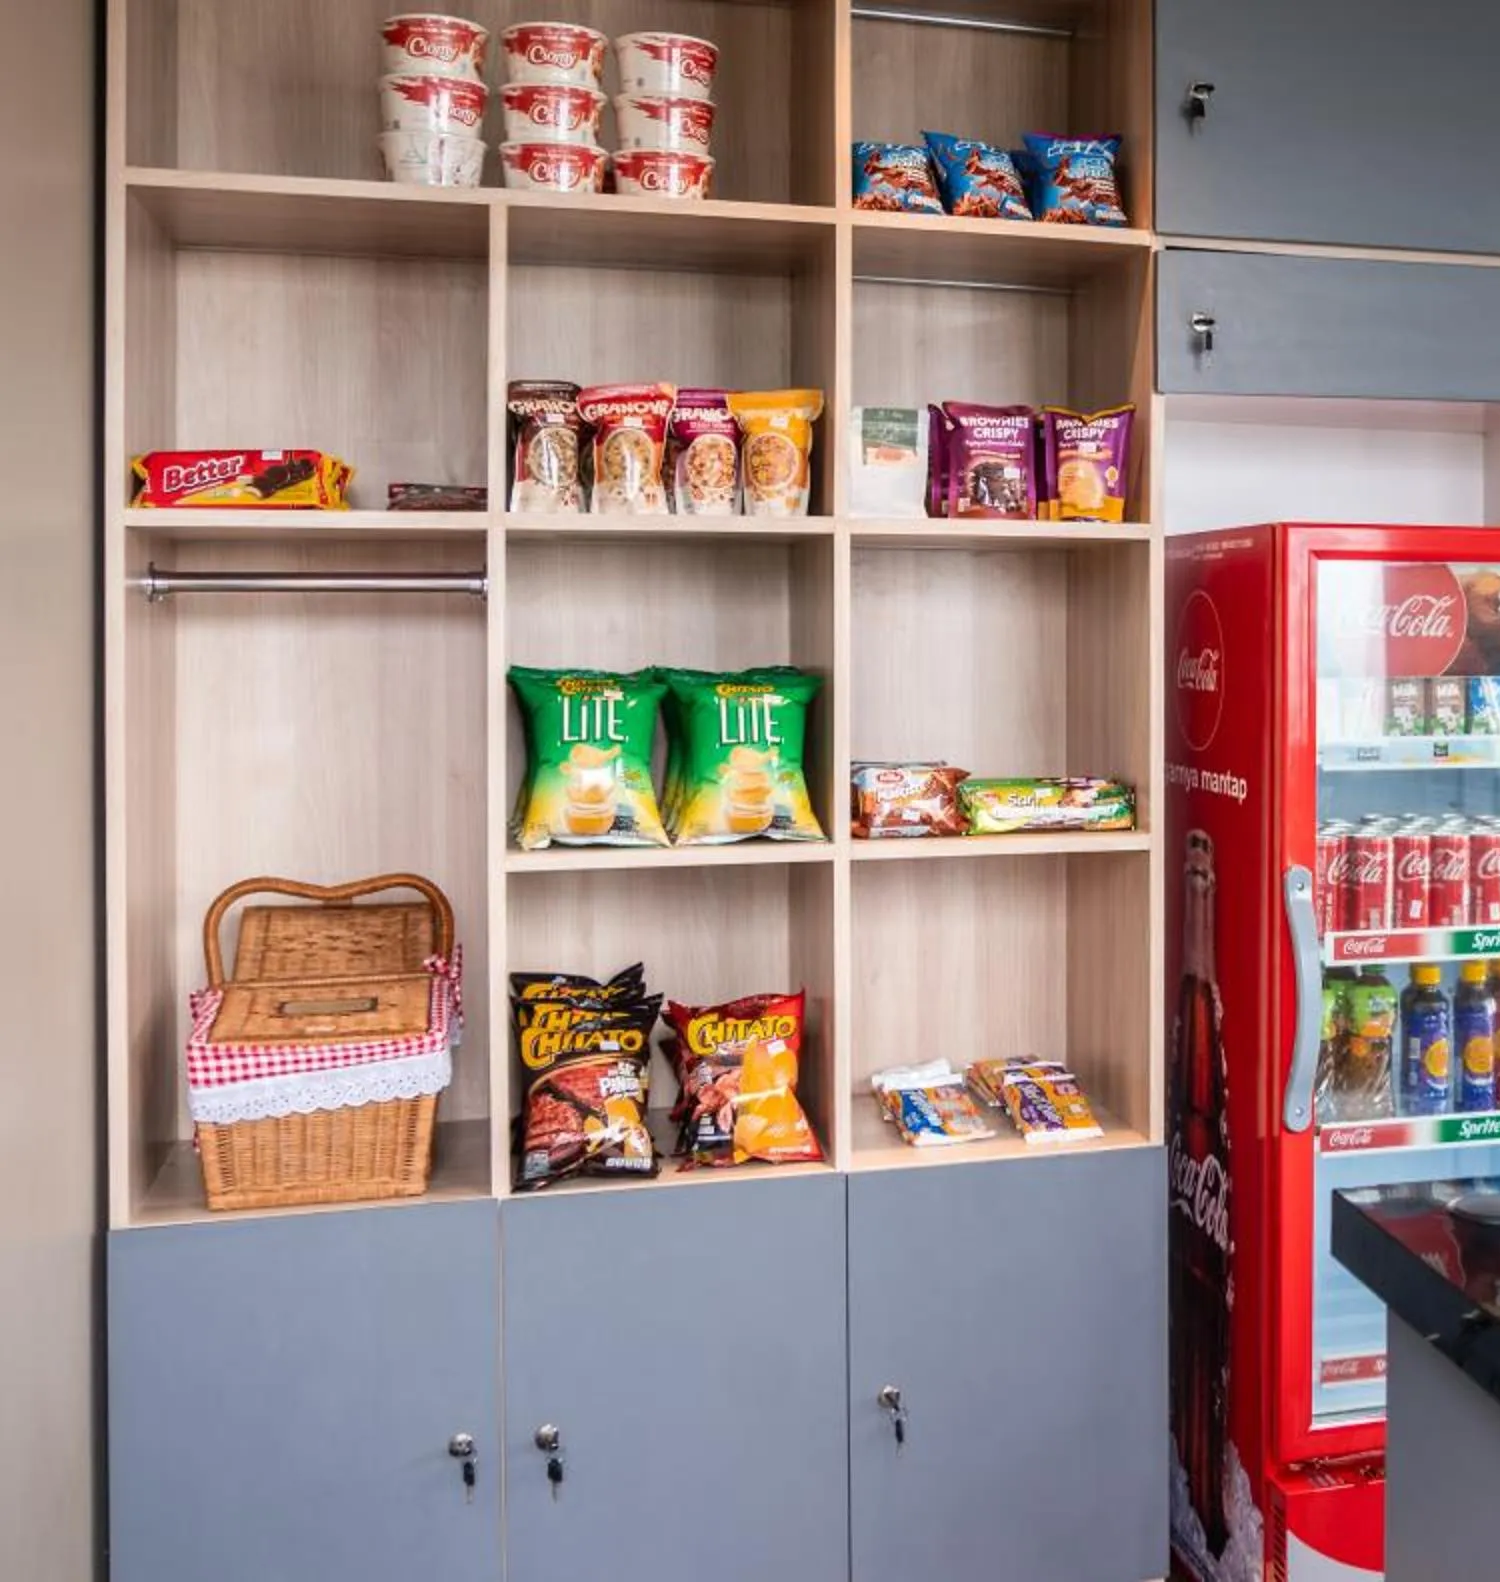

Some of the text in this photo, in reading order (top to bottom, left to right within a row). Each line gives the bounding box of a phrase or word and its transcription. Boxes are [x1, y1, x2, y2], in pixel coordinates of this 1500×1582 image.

[163, 456, 245, 492] Better
[1201, 769, 1248, 806] mantap
[521, 1028, 643, 1070] CHITATO
[687, 1012, 797, 1056] CHITATO
